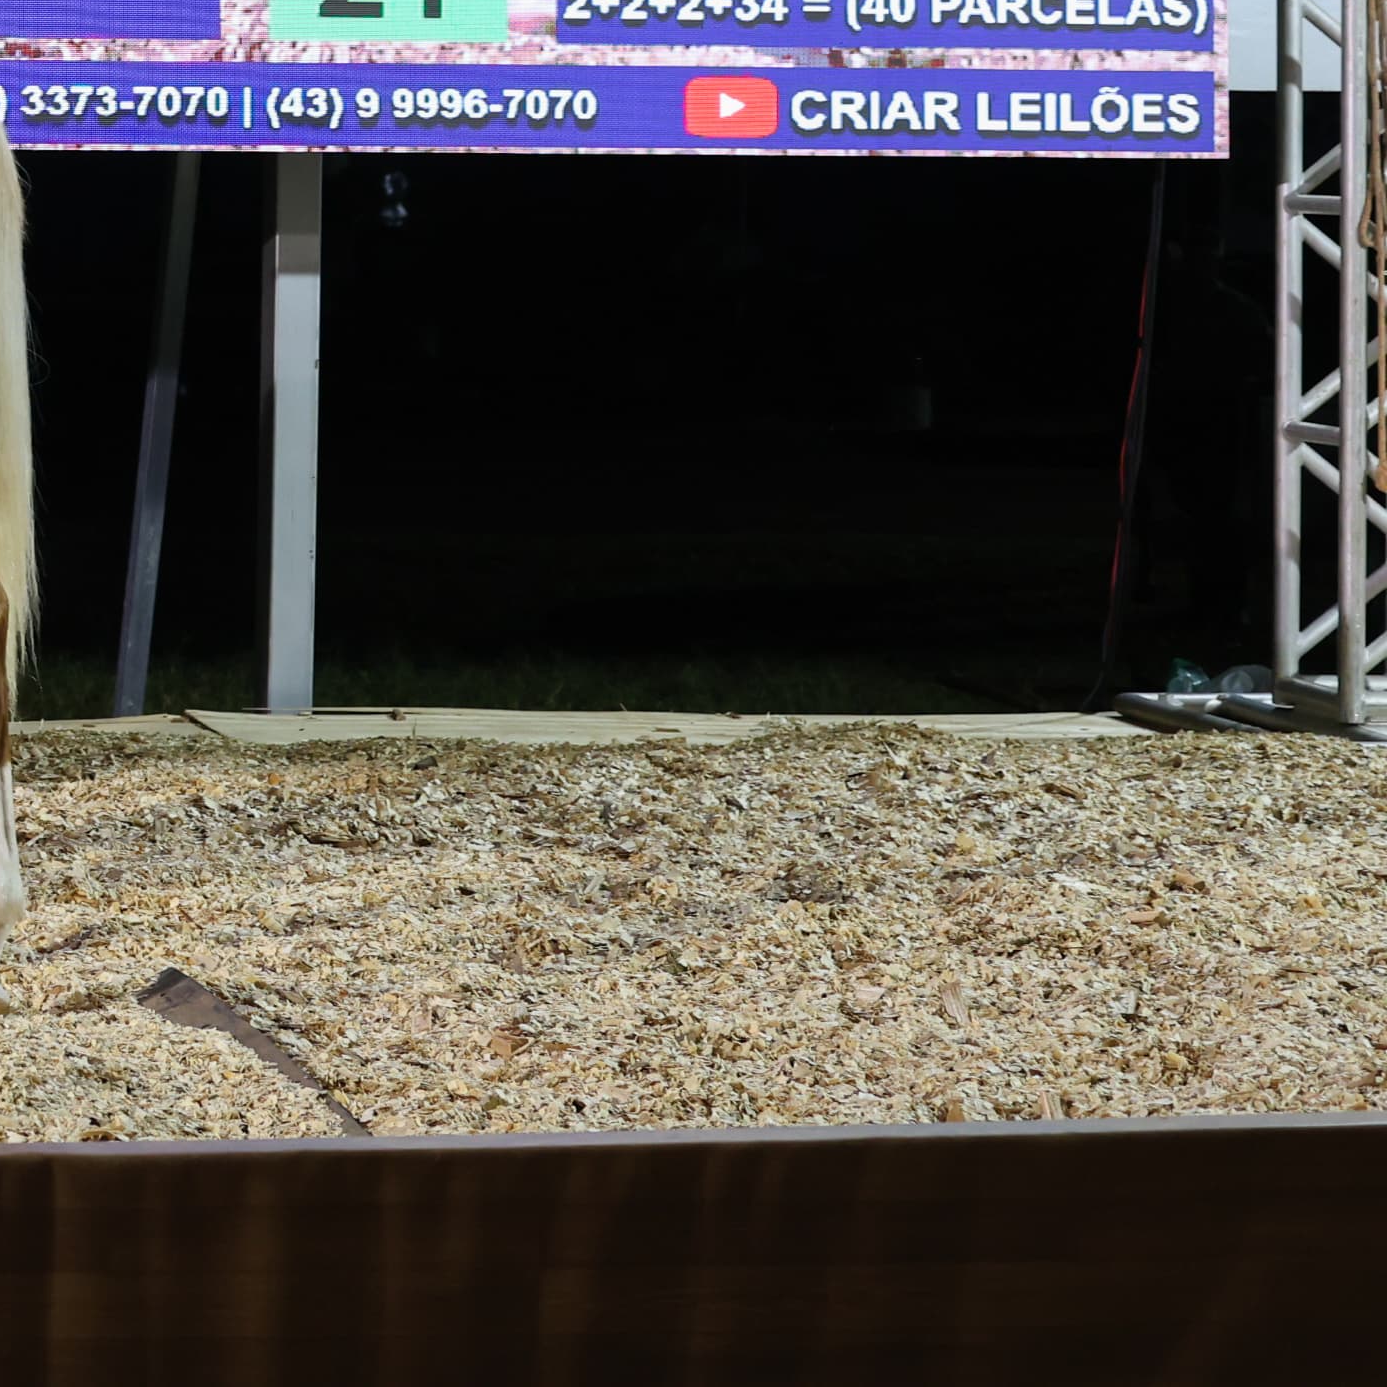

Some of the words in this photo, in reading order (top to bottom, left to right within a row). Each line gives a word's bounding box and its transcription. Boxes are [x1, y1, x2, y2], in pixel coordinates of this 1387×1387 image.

[20, 85, 229, 118] 3373-7070
[266, 89, 344, 129] (43)
[355, 90, 379, 118] 9
[393, 91, 597, 121] 9996-7070
[790, 88, 960, 132] CRIAR
[976, 86, 1200, 134] LEILÕES
